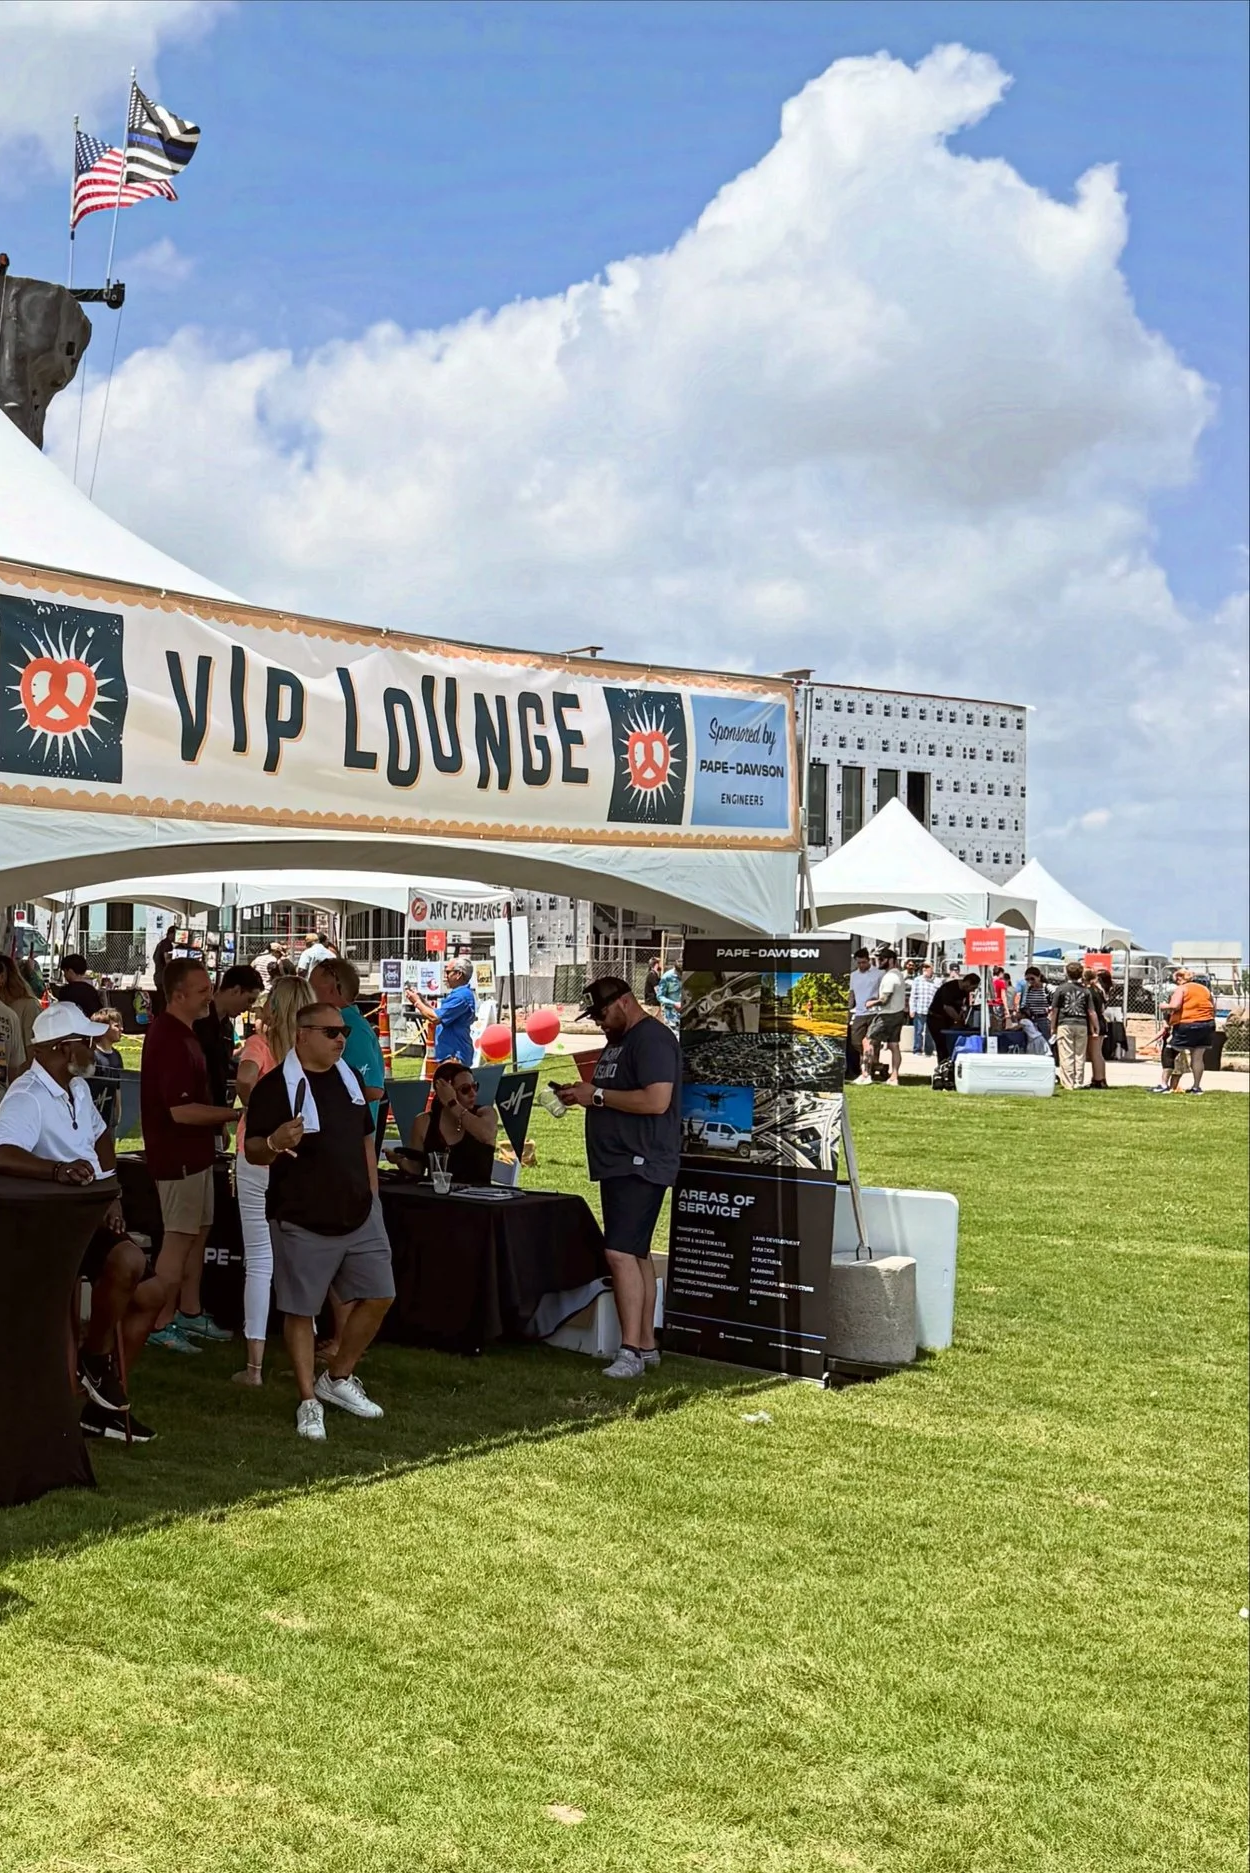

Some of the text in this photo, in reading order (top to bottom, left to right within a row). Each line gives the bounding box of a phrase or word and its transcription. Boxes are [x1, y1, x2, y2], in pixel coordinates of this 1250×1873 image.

[165, 645, 590, 791] VIP LOUNGE
[708, 717, 776, 755] Sponsored by
[699, 759, 784, 778] PAPE-DAWSON
[720, 793, 764, 807] ENGINEERS
[430, 900, 502, 922] ART EXPERIENCE
[716, 948, 820, 959] PAPE-DAWSON
[678, 1188, 756, 1207] AREAS OF
[677, 1200, 741, 1218] SERVICE
